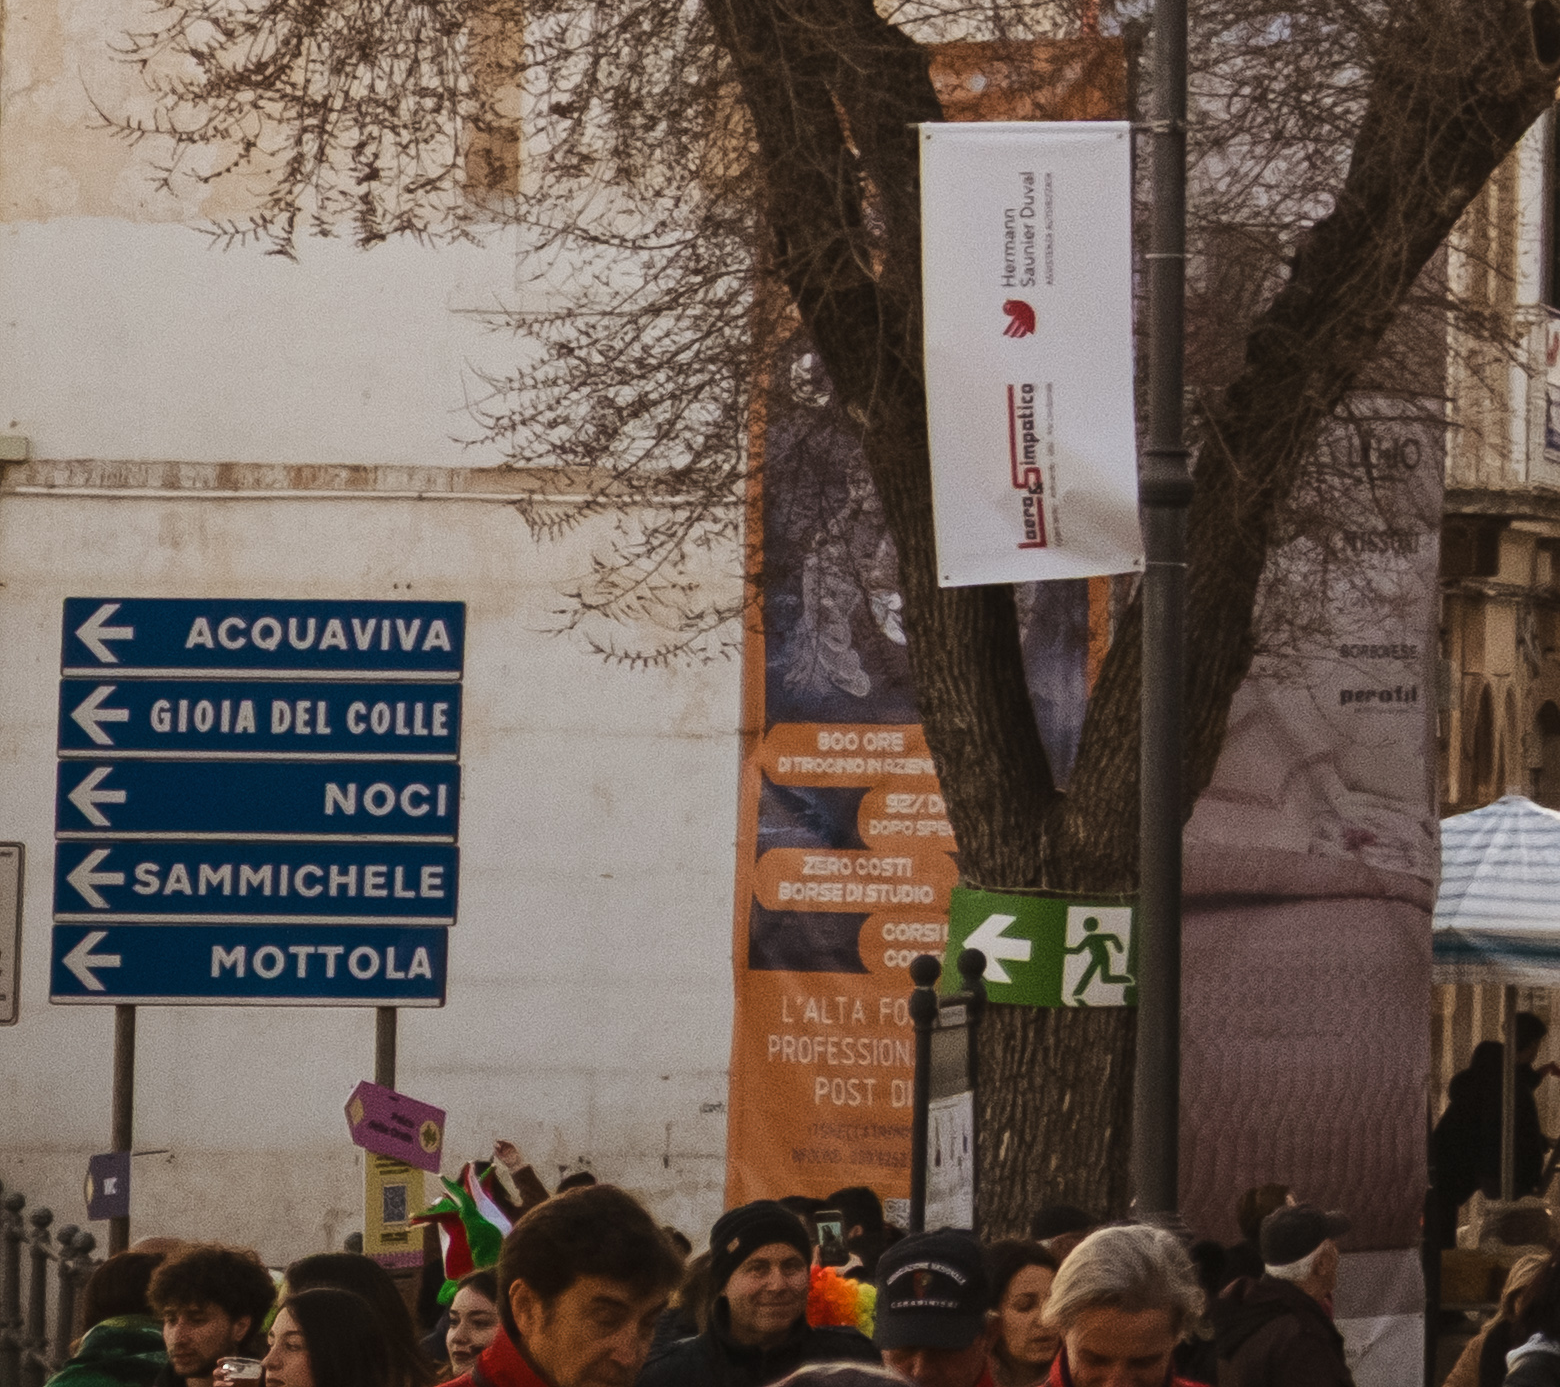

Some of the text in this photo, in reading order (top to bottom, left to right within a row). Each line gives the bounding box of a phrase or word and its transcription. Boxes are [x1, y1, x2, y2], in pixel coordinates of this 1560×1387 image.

[1020, 171, 1036, 288] Saunier Duval
[1001, 208, 1016, 288] Hermann
[186, 616, 452, 653] ACQUAVIVA
[151, 700, 449, 738] GIOIA DEL COLLE
[863, 732, 904, 752] ORE
[324, 782, 448, 818] NOCI
[133, 862, 445, 899] SAMMICHELE
[802, 855, 913, 878] ZERO COSTI
[778, 881, 935, 904] BORSE DI STUDIO
[211, 944, 432, 981] MOTTOLA
[781, 994, 867, 1026] L'ALTA
[767, 1034, 915, 1068] PROFESSION
[814, 1075, 876, 1107] POST
